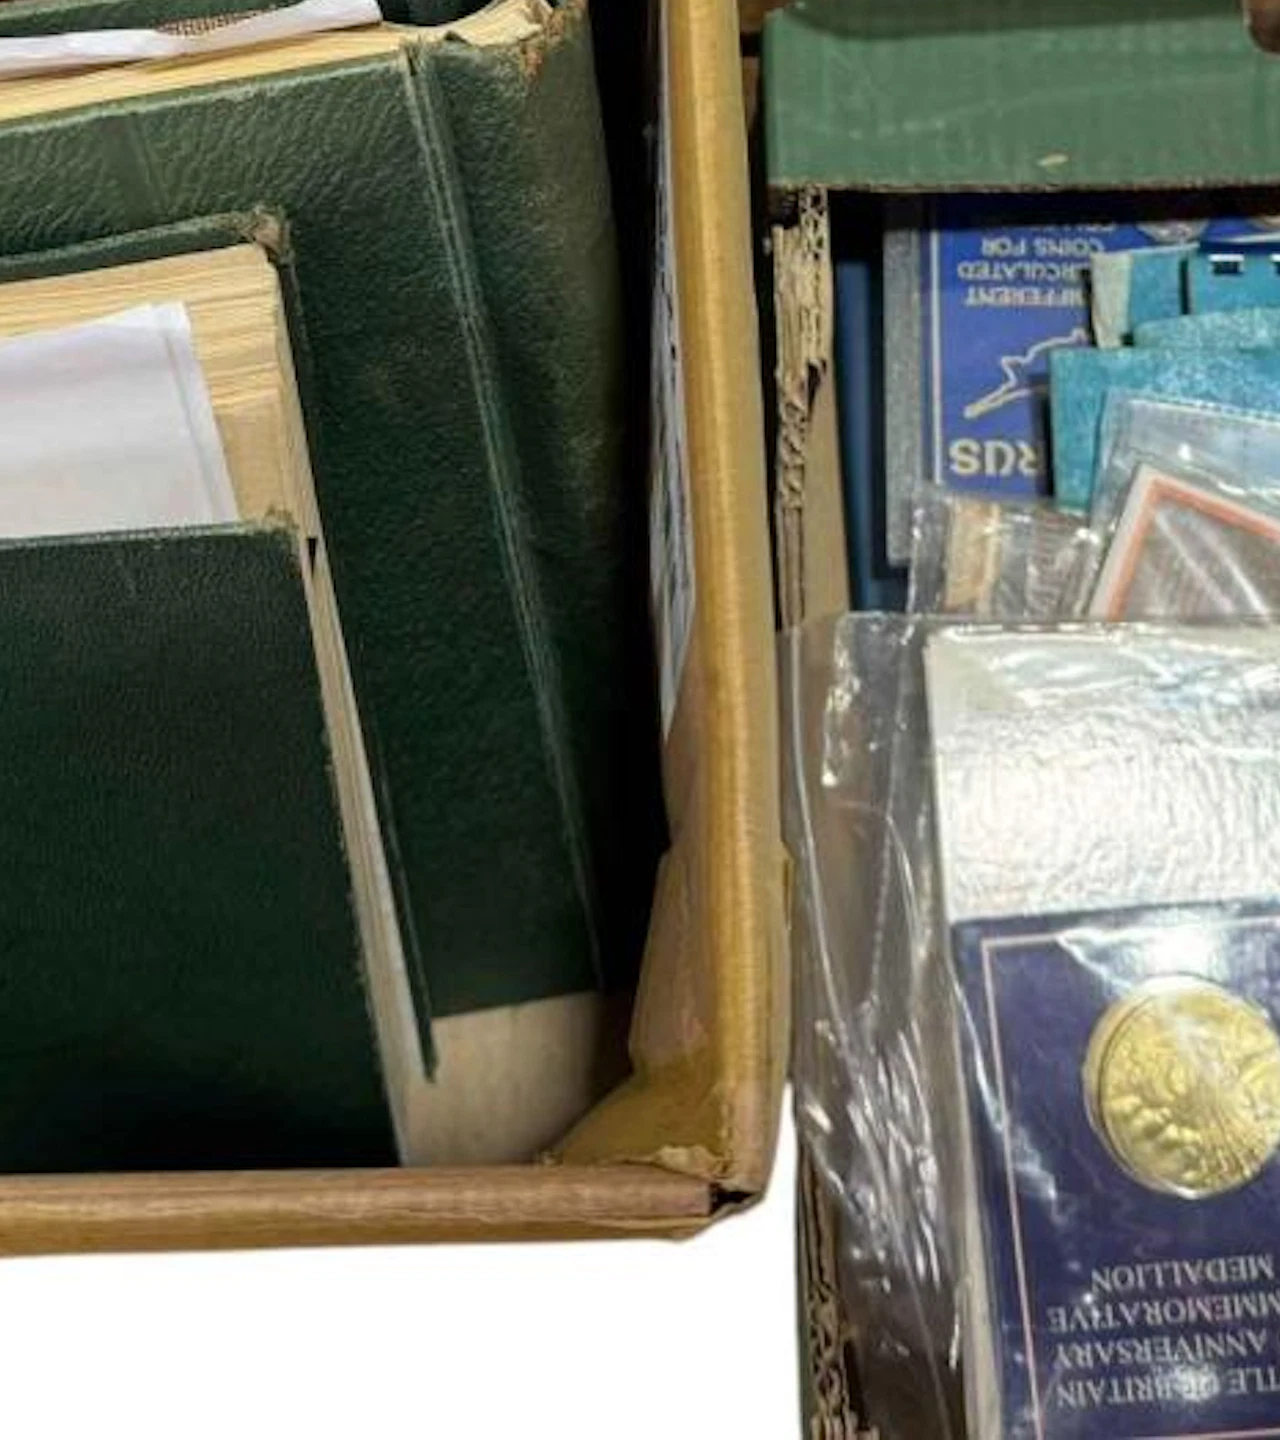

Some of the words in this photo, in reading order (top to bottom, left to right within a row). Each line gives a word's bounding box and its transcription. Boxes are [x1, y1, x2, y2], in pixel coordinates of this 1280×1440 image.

[981, 236, 1027, 258] FOR
[1032, 236, 1106, 258] COINS
[948, 438, 1038, 477] RUS
[1091, 1254, 1275, 1293] MEDALLION
[1054, 1328, 1268, 1370] ANNIVERSARY
[1056, 1374, 1175, 1410] BRITAIN
